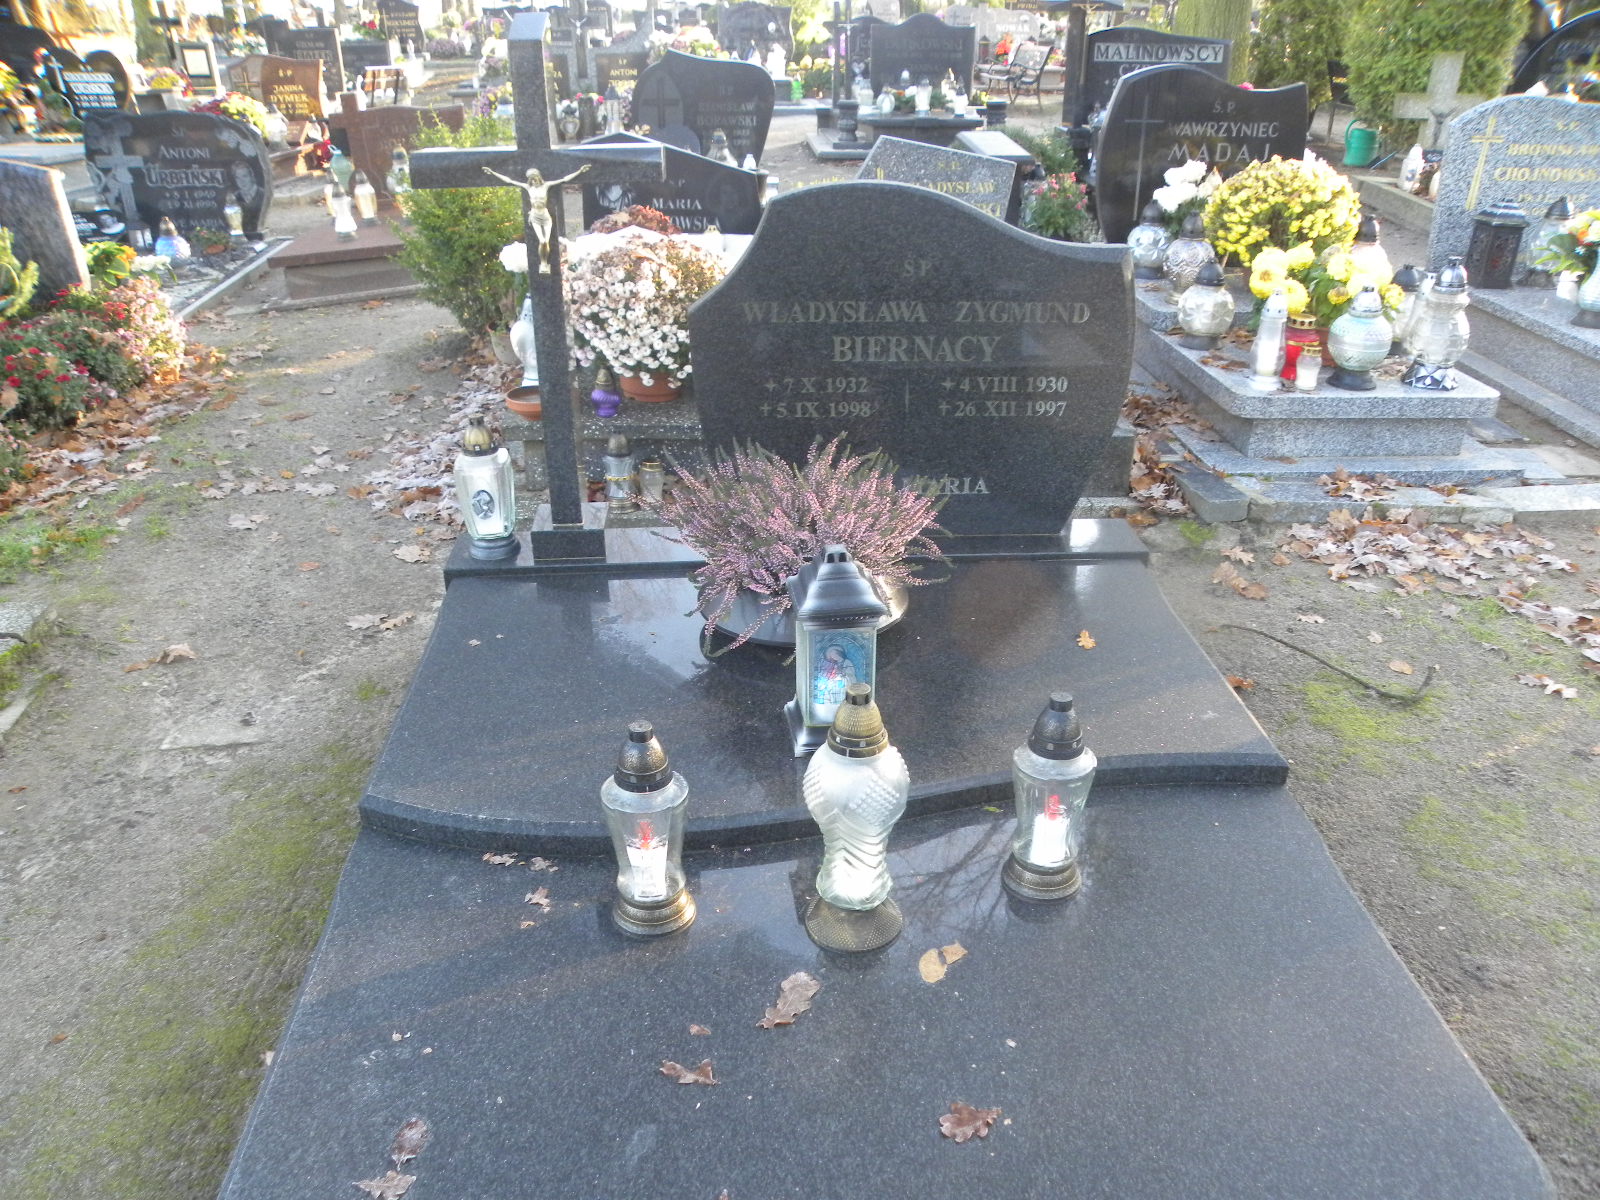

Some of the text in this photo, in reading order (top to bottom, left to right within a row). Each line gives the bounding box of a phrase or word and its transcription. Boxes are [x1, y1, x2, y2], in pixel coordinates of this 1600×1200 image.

[1095, 44, 1223, 62] MALINOWSCY
[272, 85, 304, 93] JANINA
[270, 94, 308, 104] DYMEK
[1168, 121, 1280, 138] WAWRZYNIEC
[159, 144, 211, 160] ANTONI
[1168, 143, 1271, 163] MADAJ
[147, 164, 226, 188] URBAŃSKI
[652, 198, 703, 211] MARIA
[669, 216, 722, 231] OWSKA
[954, 301, 1091, 324] ZYGMUND
[832, 335, 1001, 363] BIERNACY
[827, 376, 869, 394] 1932
[1027, 376, 1068, 393] 1930
[829, 402, 872, 418] 1998
[1026, 400, 1067, 417] 1997
[902, 476, 991, 495] RIA
